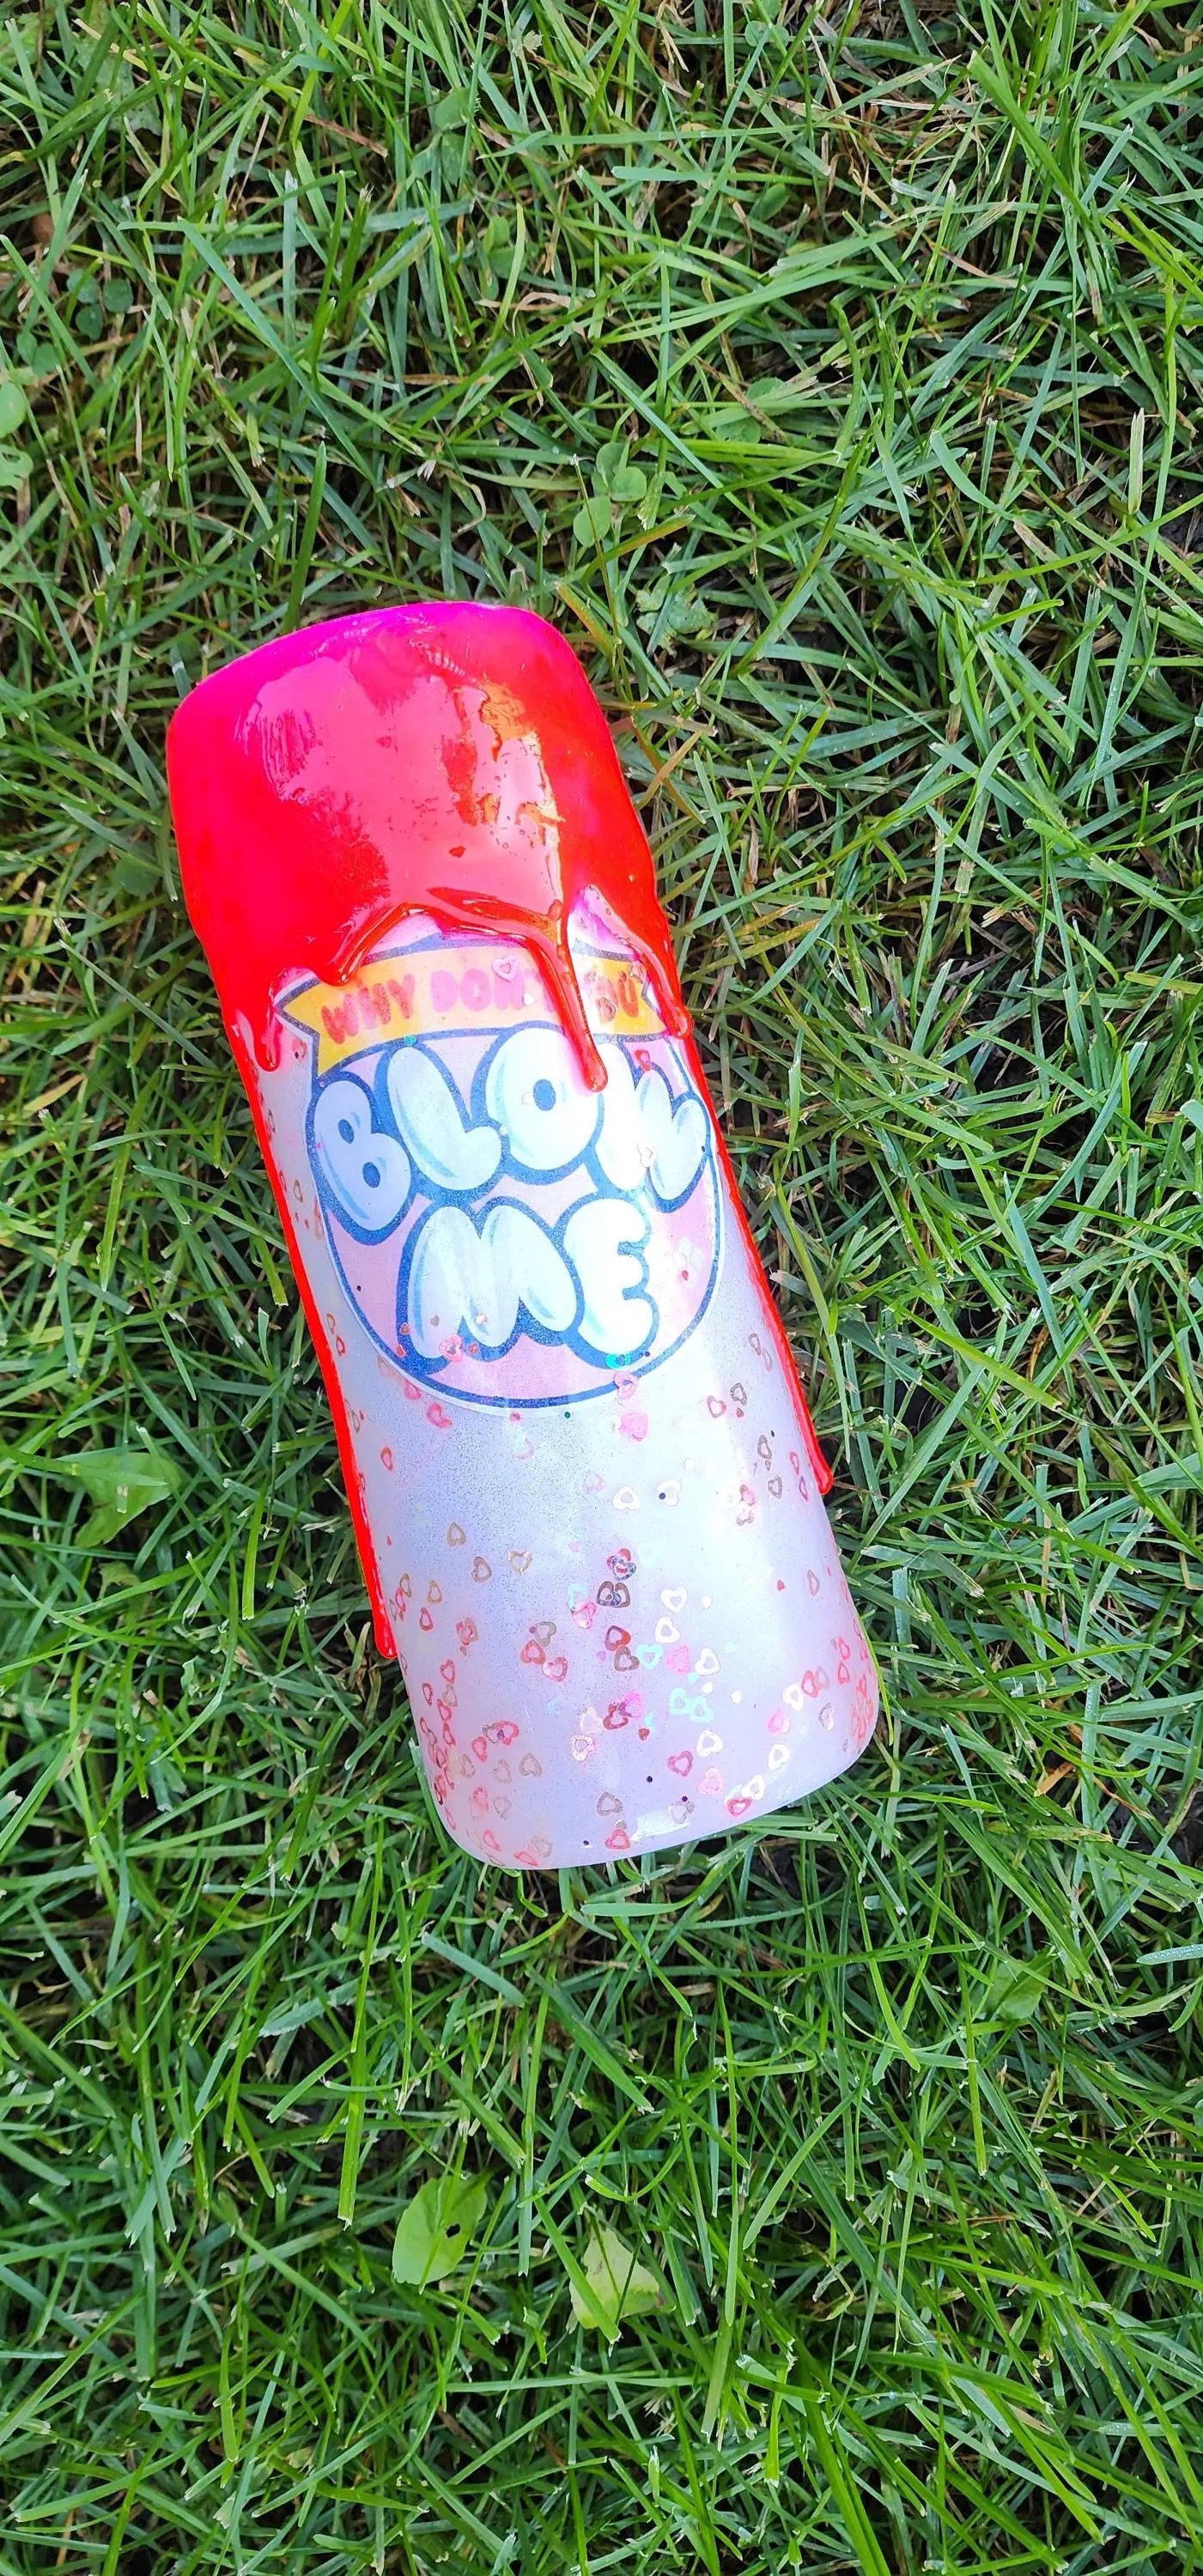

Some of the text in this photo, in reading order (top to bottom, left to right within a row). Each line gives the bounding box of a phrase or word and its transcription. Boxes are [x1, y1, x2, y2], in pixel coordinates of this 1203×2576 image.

[320, 973, 416, 1045] WHY
[308, 1023, 710, 1239] BLOW
[400, 1194, 659, 1368] ME
